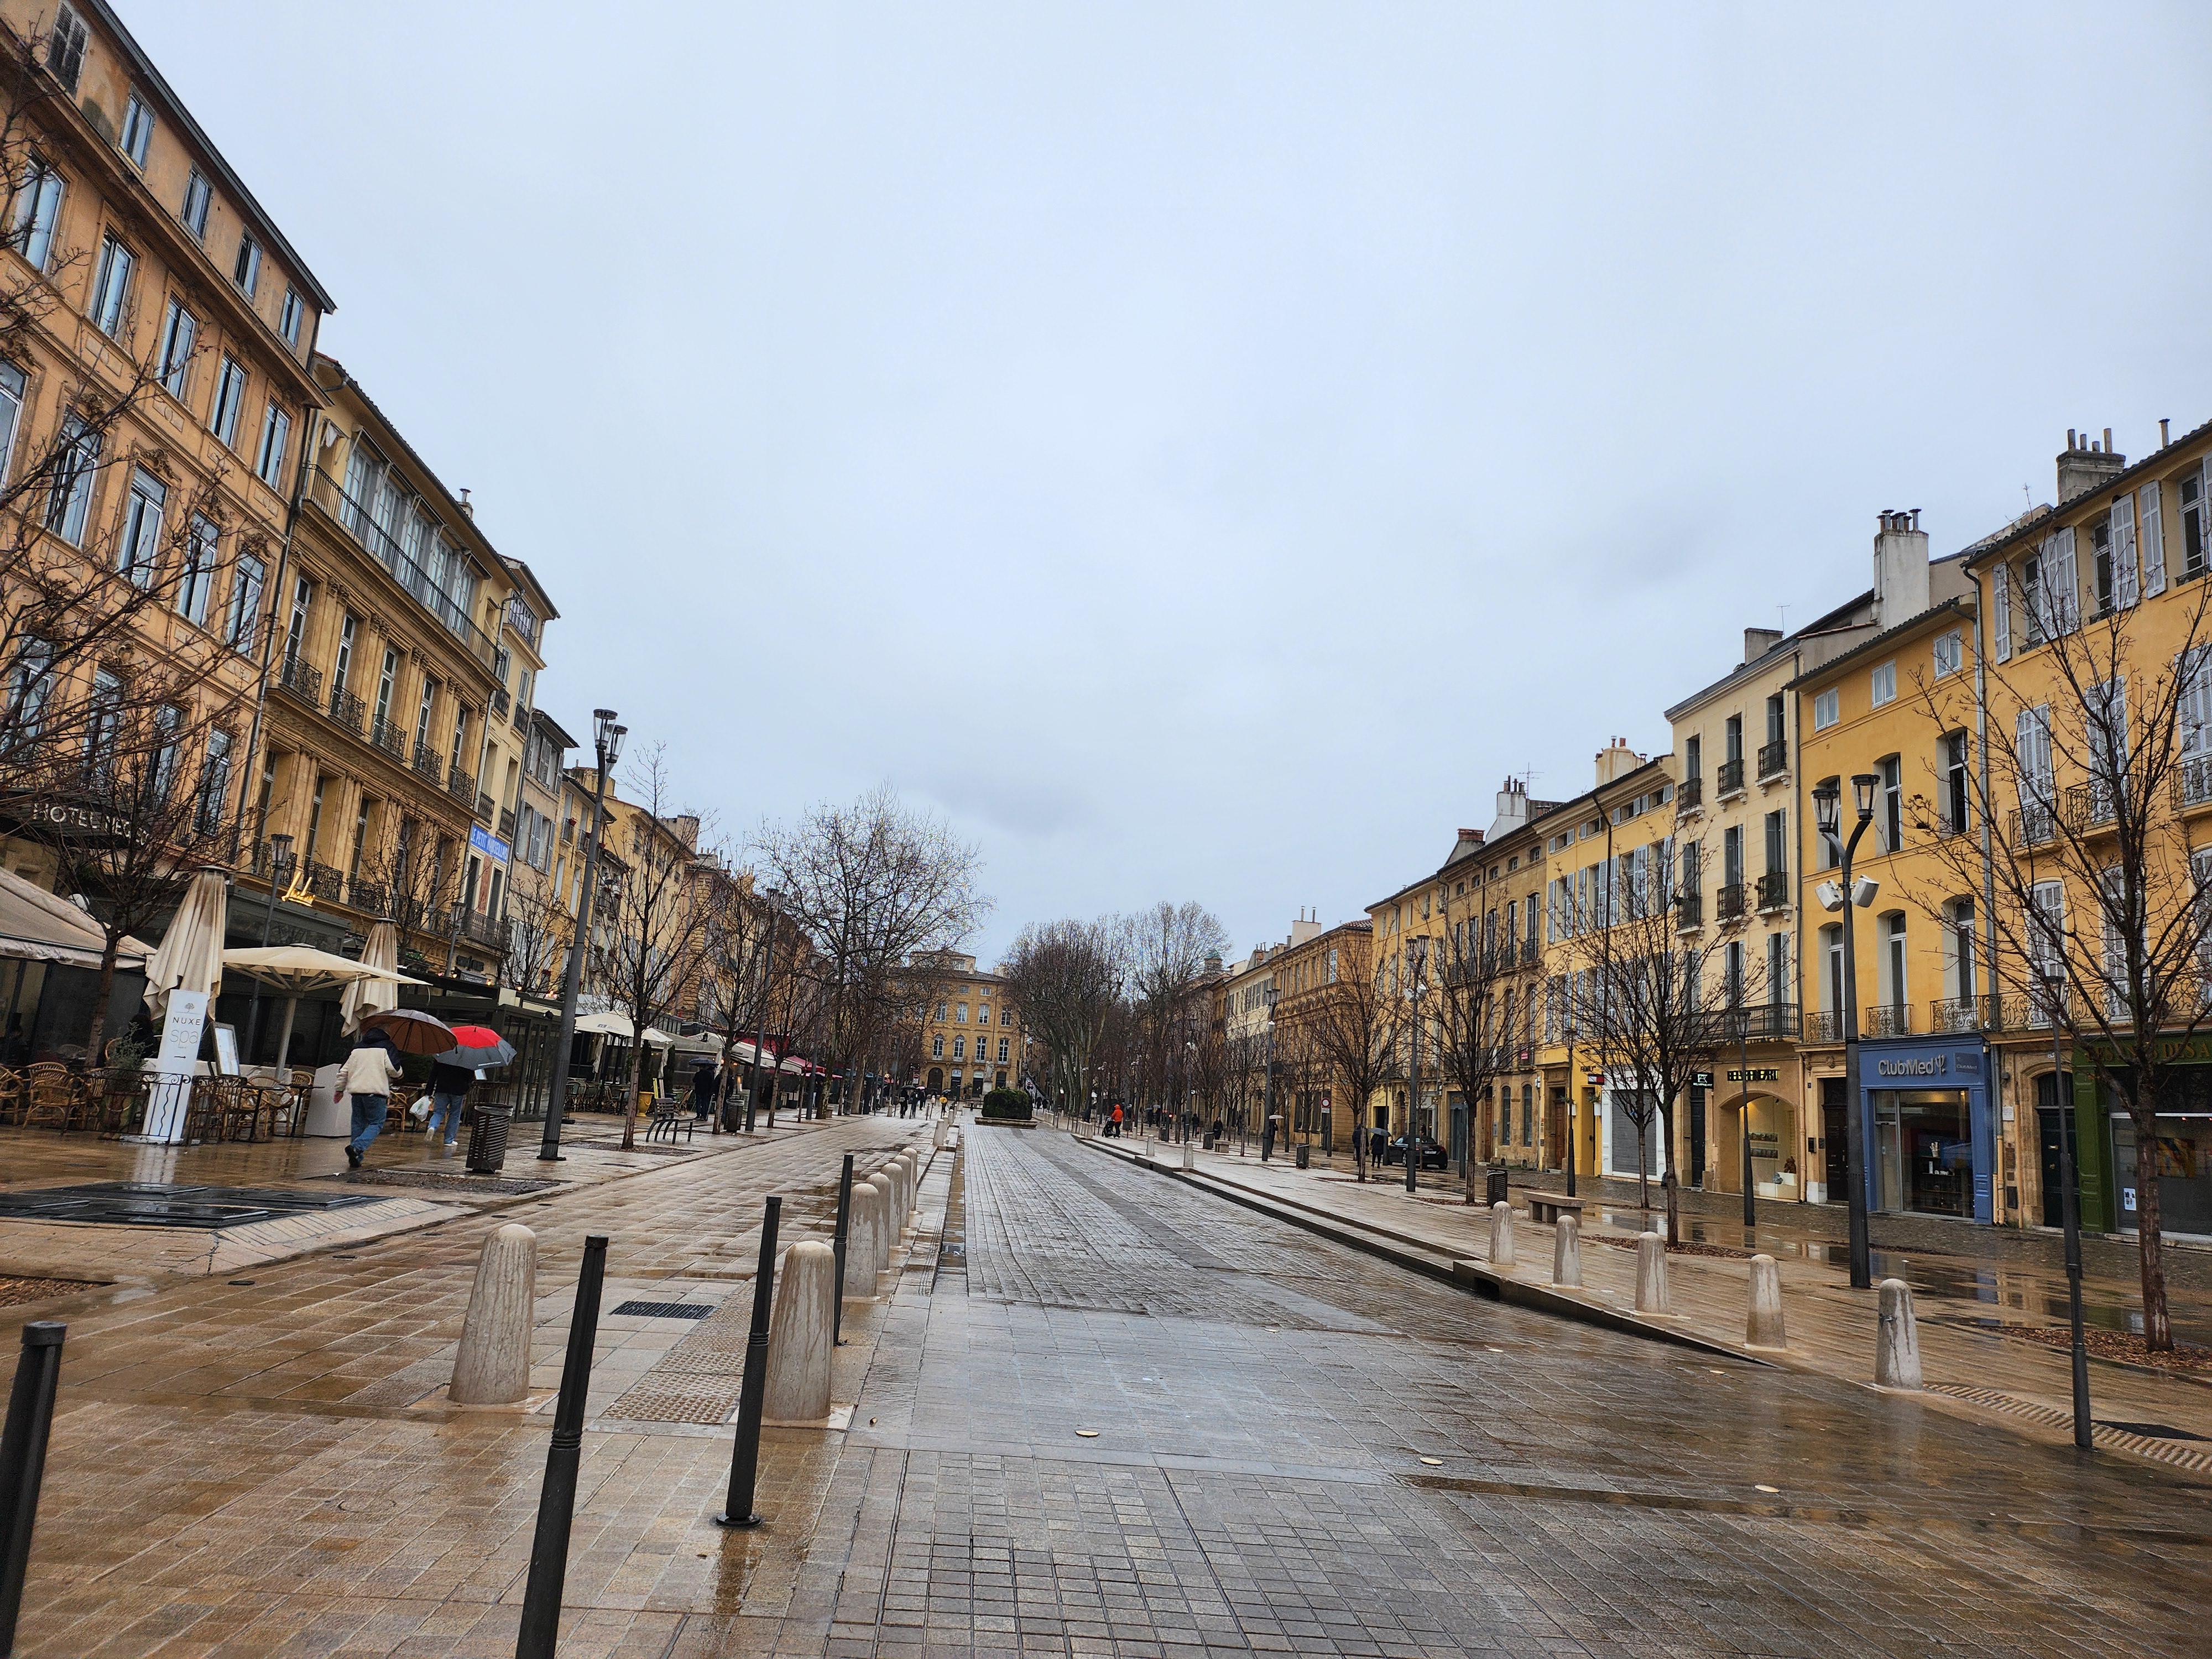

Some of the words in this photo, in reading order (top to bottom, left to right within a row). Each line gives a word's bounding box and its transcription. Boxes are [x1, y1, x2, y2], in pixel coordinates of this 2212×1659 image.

[33, 802, 97, 829] HOTEL
[173, 1017, 201, 1025] NUXE
[170, 1030, 199, 1046] spa
